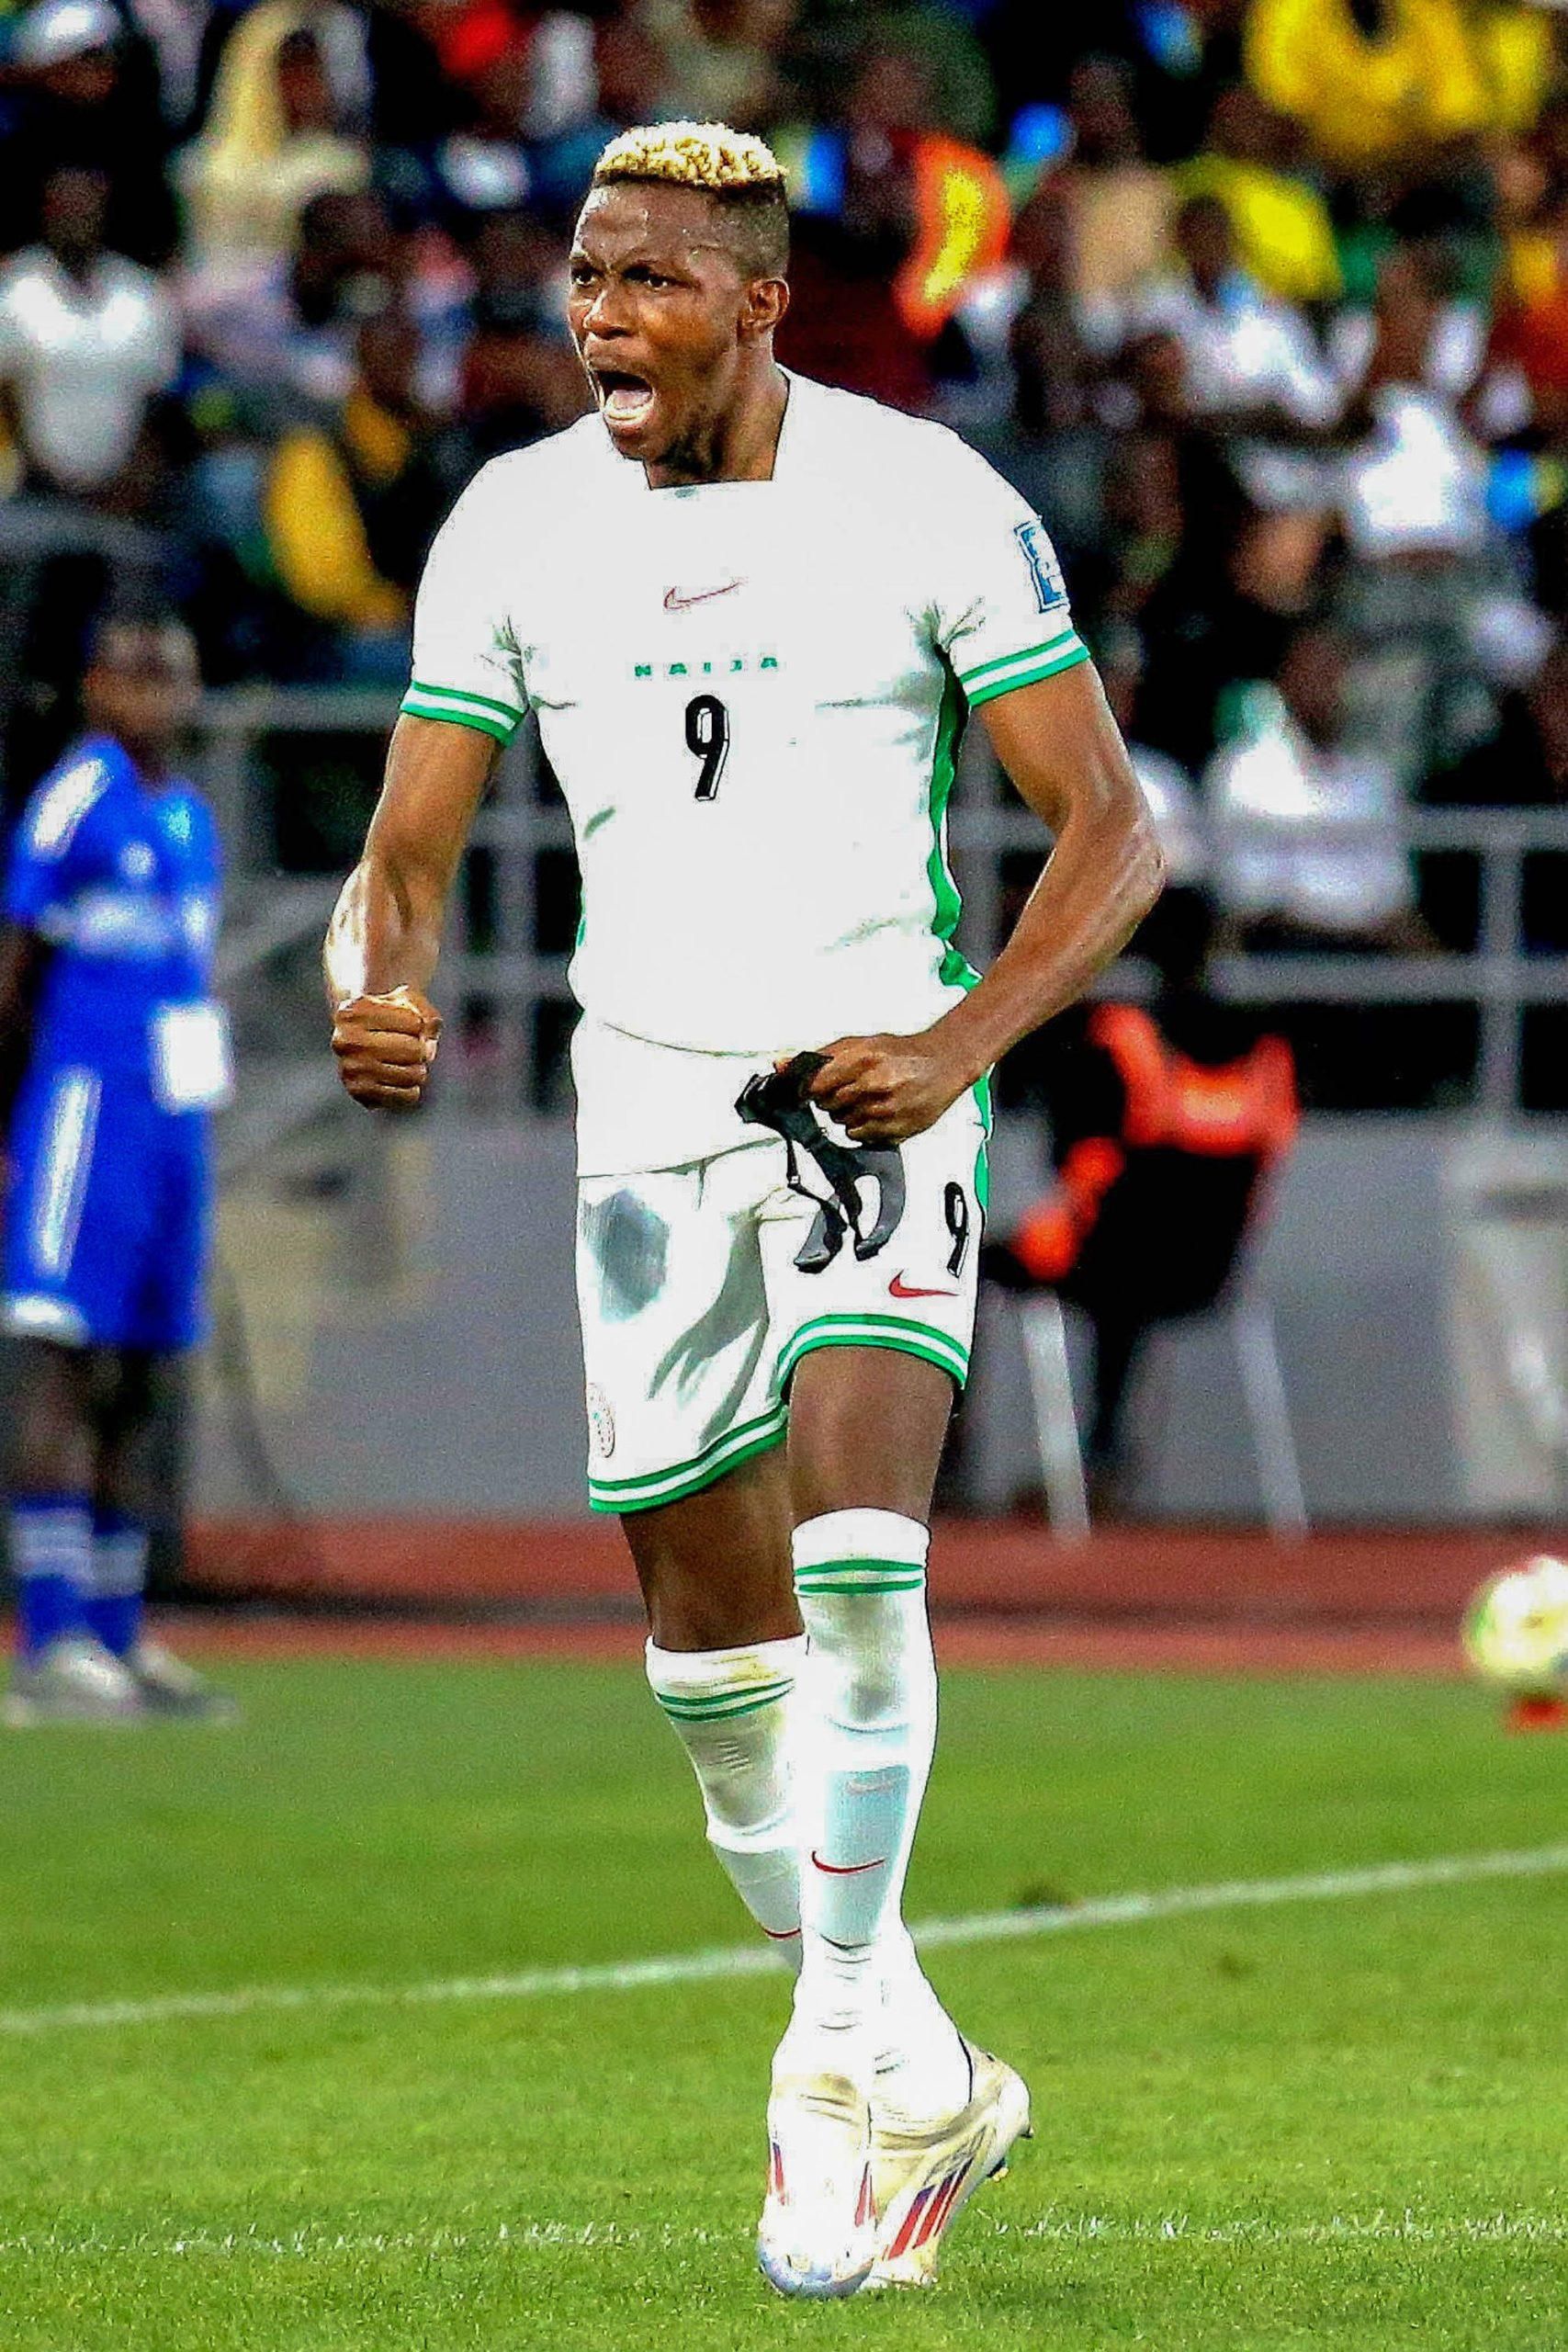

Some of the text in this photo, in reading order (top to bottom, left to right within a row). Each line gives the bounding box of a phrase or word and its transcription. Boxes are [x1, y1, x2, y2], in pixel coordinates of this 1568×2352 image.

[634, 657, 778, 677] NAIJA
[685, 694, 730, 802] 9
[944, 1181, 970, 1279] 9
